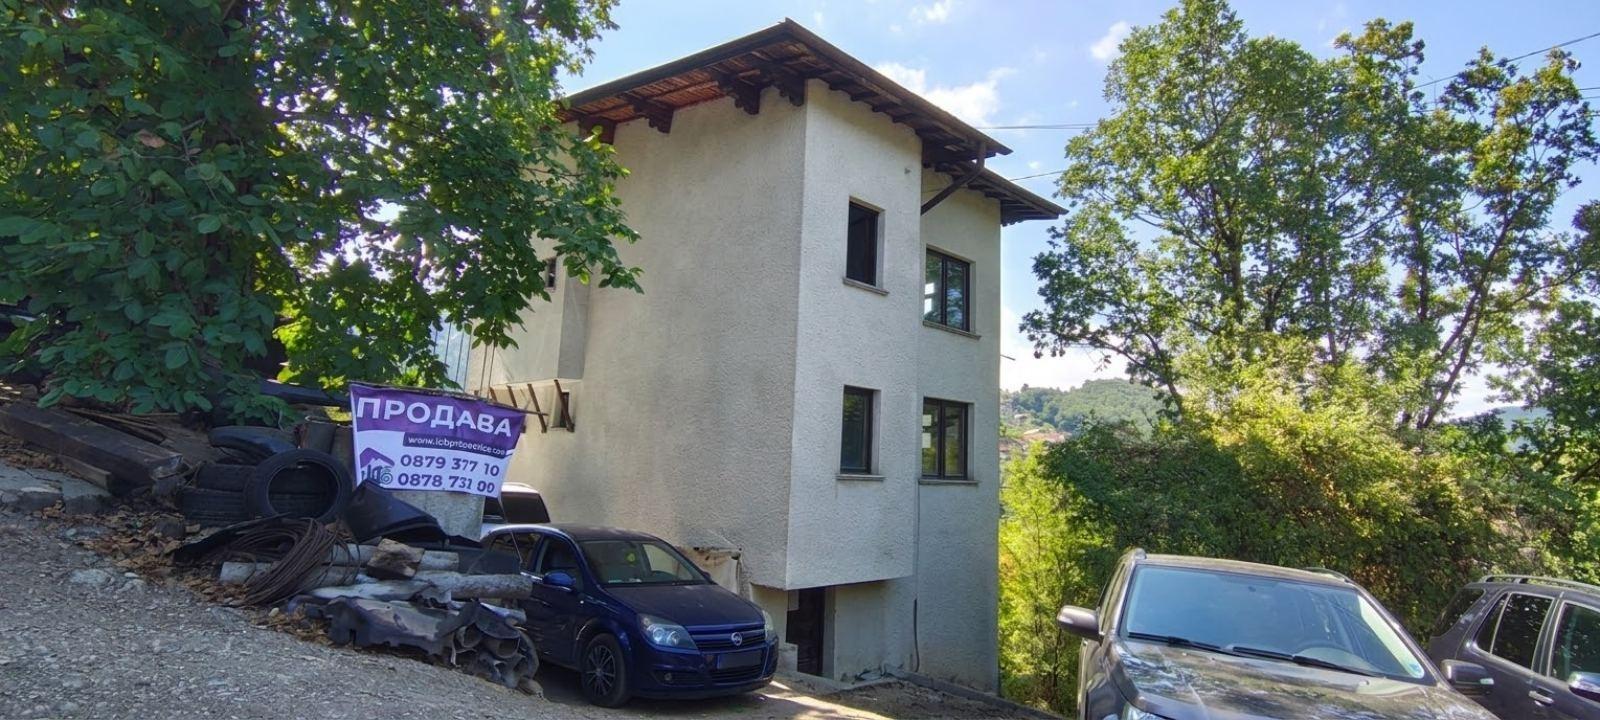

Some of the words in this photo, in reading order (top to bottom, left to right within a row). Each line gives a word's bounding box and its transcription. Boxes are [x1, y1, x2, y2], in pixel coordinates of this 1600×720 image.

[356, 397, 512, 437] ПРОДАВА
[400, 454, 446, 469] 0879
[452, 457, 478, 472] 377
[484, 463, 500, 477] 10
[398, 473, 443, 487] 0878
[448, 475, 472, 490] 731
